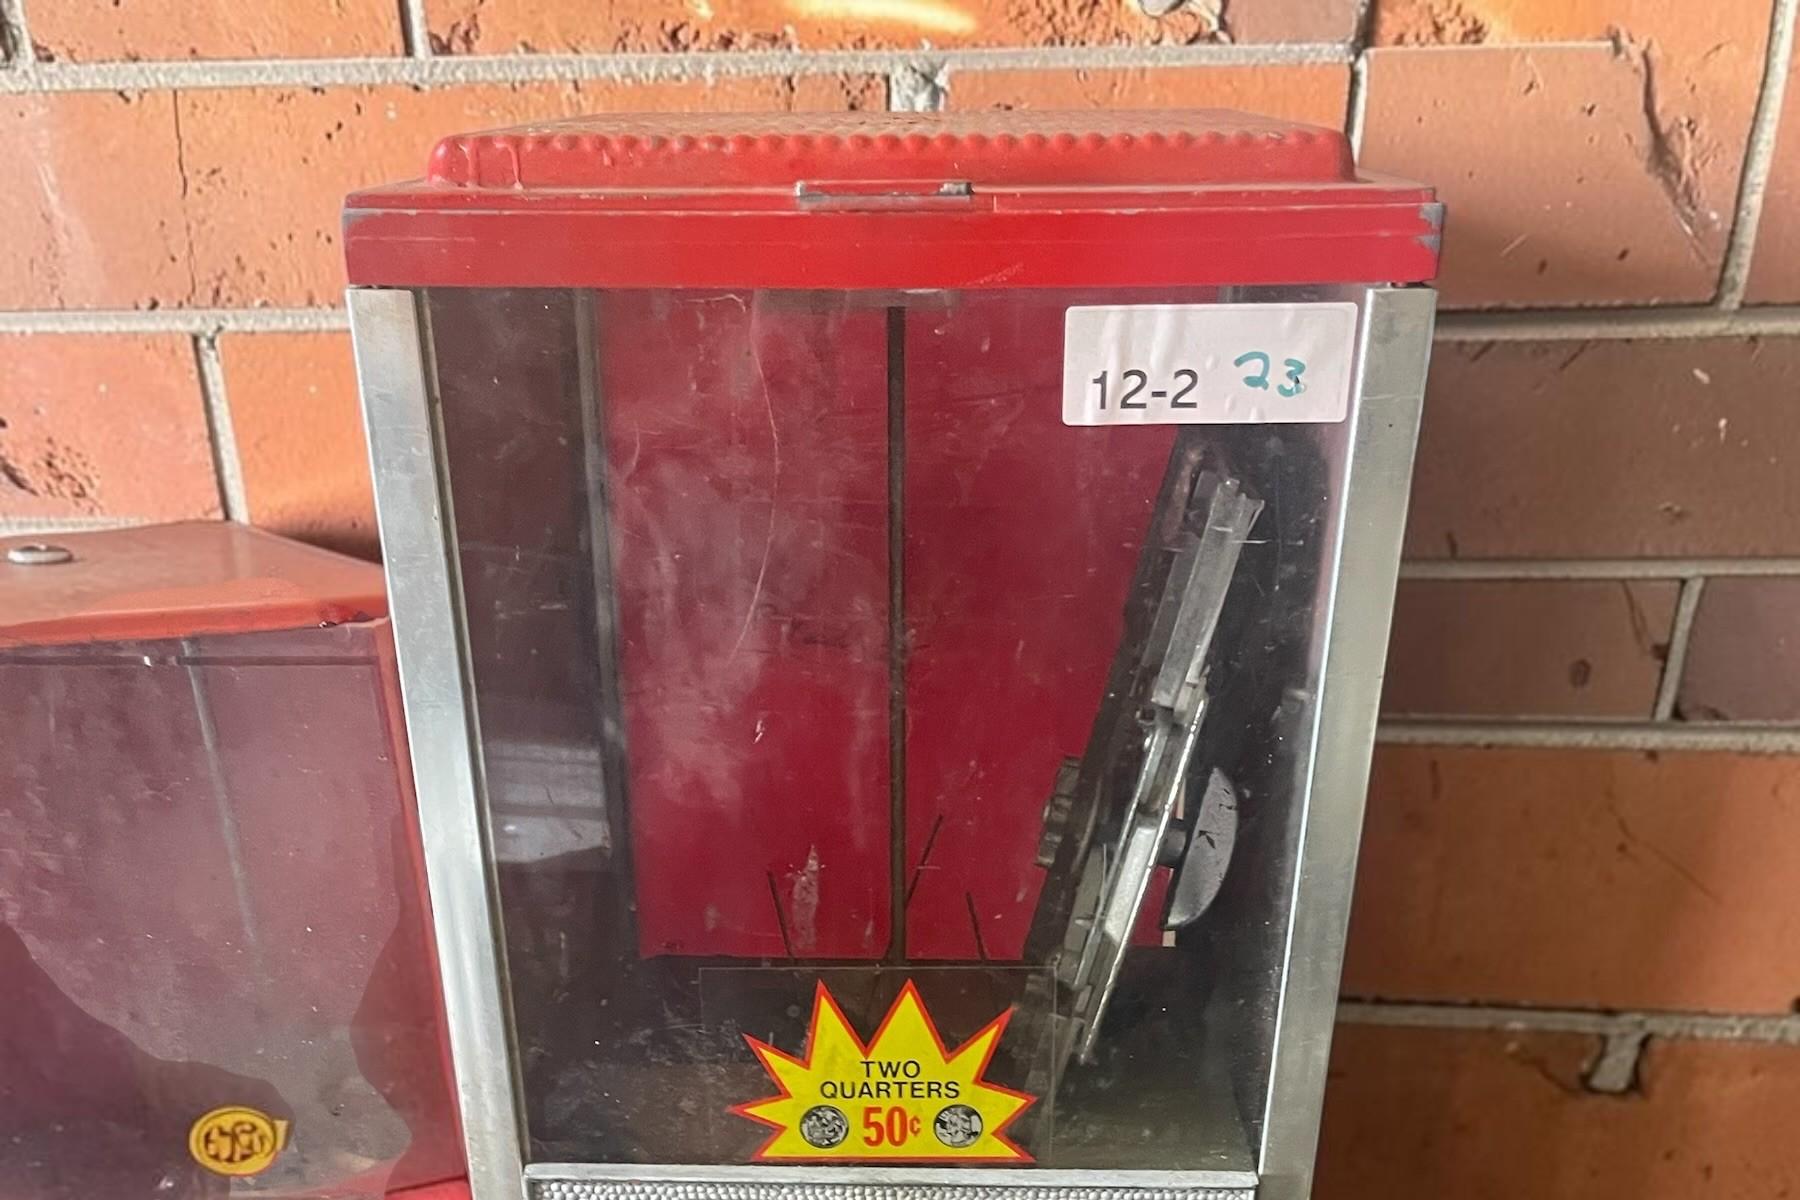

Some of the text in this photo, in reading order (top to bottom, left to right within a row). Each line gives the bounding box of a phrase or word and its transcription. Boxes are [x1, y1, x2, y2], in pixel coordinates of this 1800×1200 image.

[1092, 369, 1199, 410] 12-2
[1233, 351, 1307, 398] 23
[861, 1060, 921, 1078] TWO
[820, 1081, 960, 1099] QUARTERS
[863, 1106, 922, 1147] 50¢
